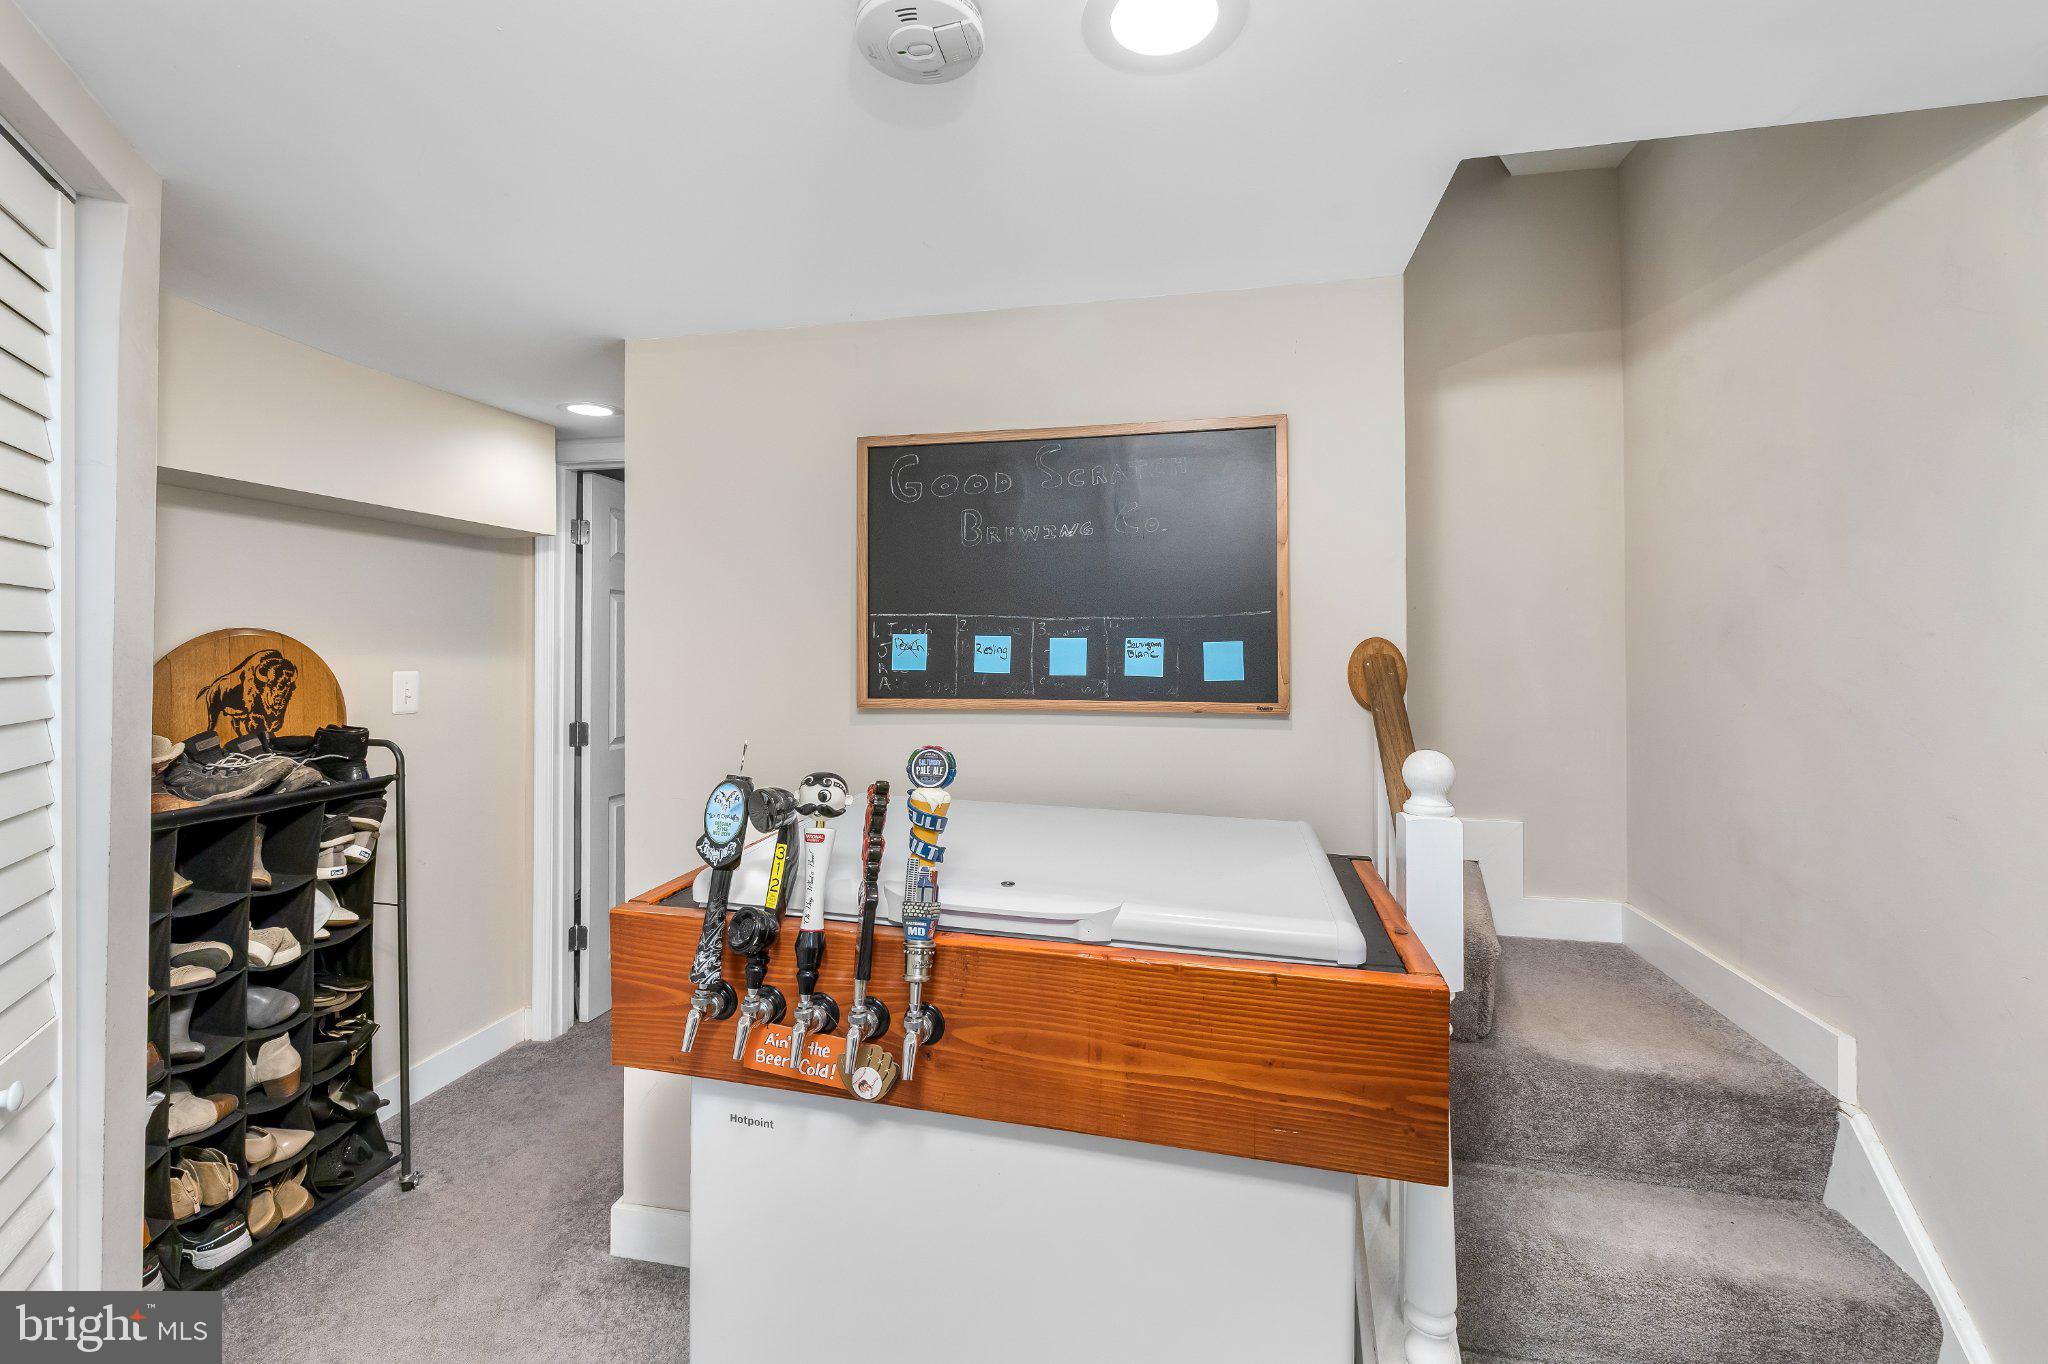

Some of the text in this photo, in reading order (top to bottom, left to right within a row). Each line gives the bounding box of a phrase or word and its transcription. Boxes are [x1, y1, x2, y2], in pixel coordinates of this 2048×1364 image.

[890, 453, 1012, 503] GOOD
[960, 508, 1094, 547] BREWING
[1126, 649, 1160, 659] Blanc
[916, 766, 944, 775] PALE ALE
[907, 926, 926, 936] MD
[808, 1041, 831, 1058] the
[755, 1048, 836, 1080] Beer Cold!
[730, 1113, 774, 1129] Hotpoint
